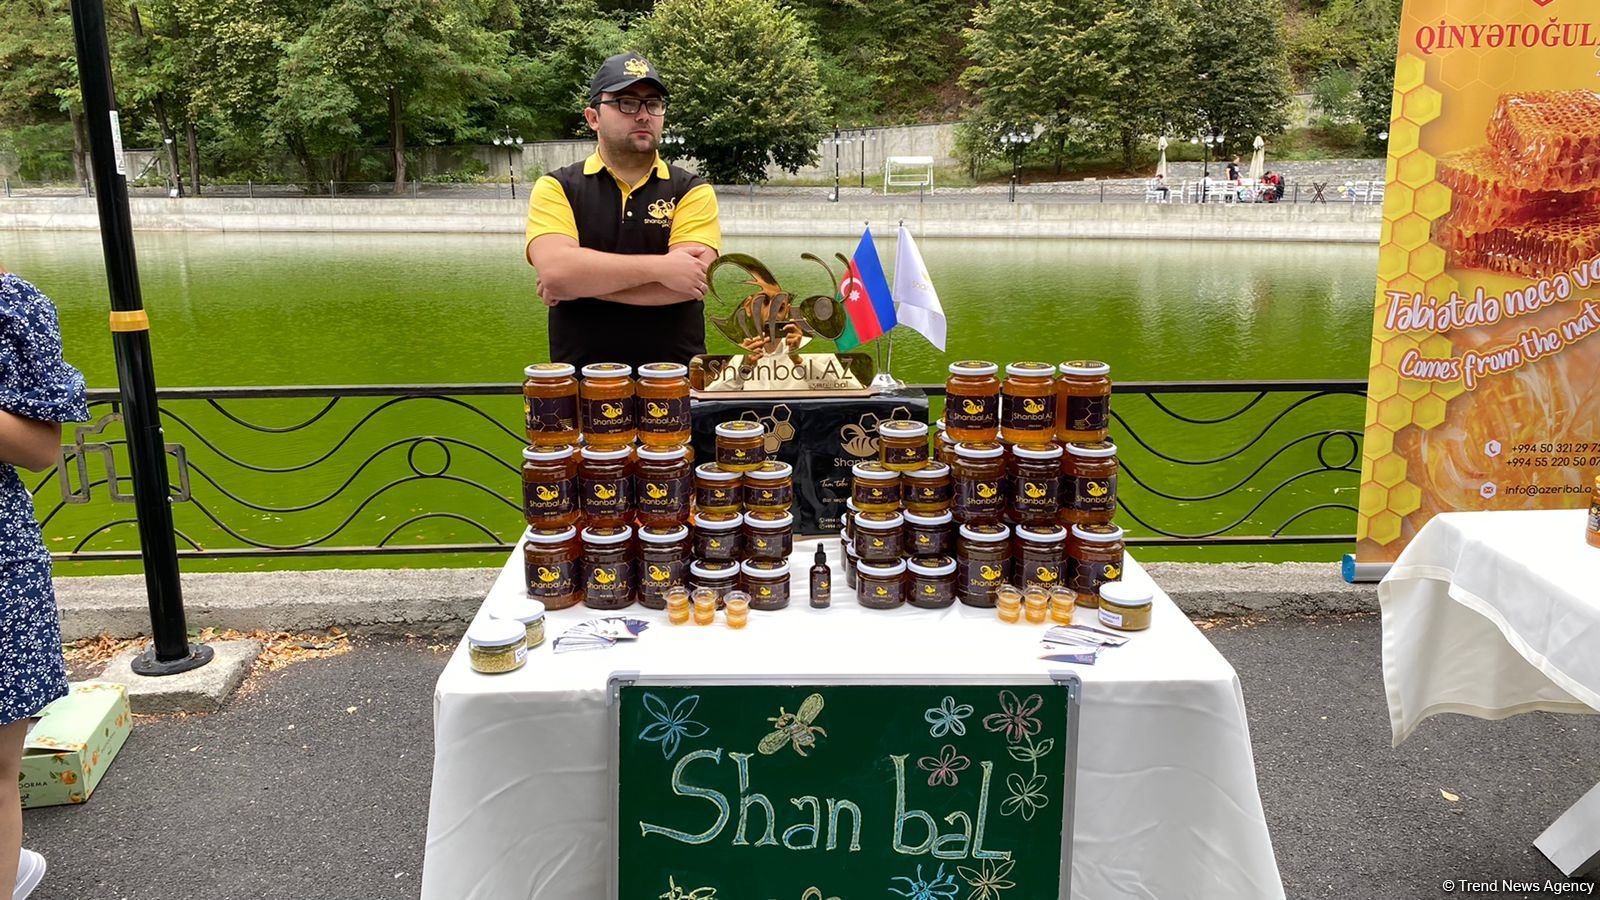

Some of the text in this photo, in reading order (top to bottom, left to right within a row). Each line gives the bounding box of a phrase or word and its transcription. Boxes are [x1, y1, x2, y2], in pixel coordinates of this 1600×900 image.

[1415, 17, 1600, 54] QİNYƏTOĞUL
[708, 358, 853, 381] Shanbal.AZ
[1400, 350, 1460, 379] Comes
[1464, 347, 1520, 387] from
[1519, 330, 1561, 360] the
[1506, 457, 1531, 467] +994
[1534, 457, 1548, 467] 55
[1551, 457, 1570, 467] 220
[1572, 457, 1587, 466] 50
[1512, 444, 1537, 454] +994
[1540, 443, 1554, 453] 50
[1556, 443, 1573, 453] 321
[1575, 443, 1588, 453] 29
[639, 747, 862, 851] Shan
